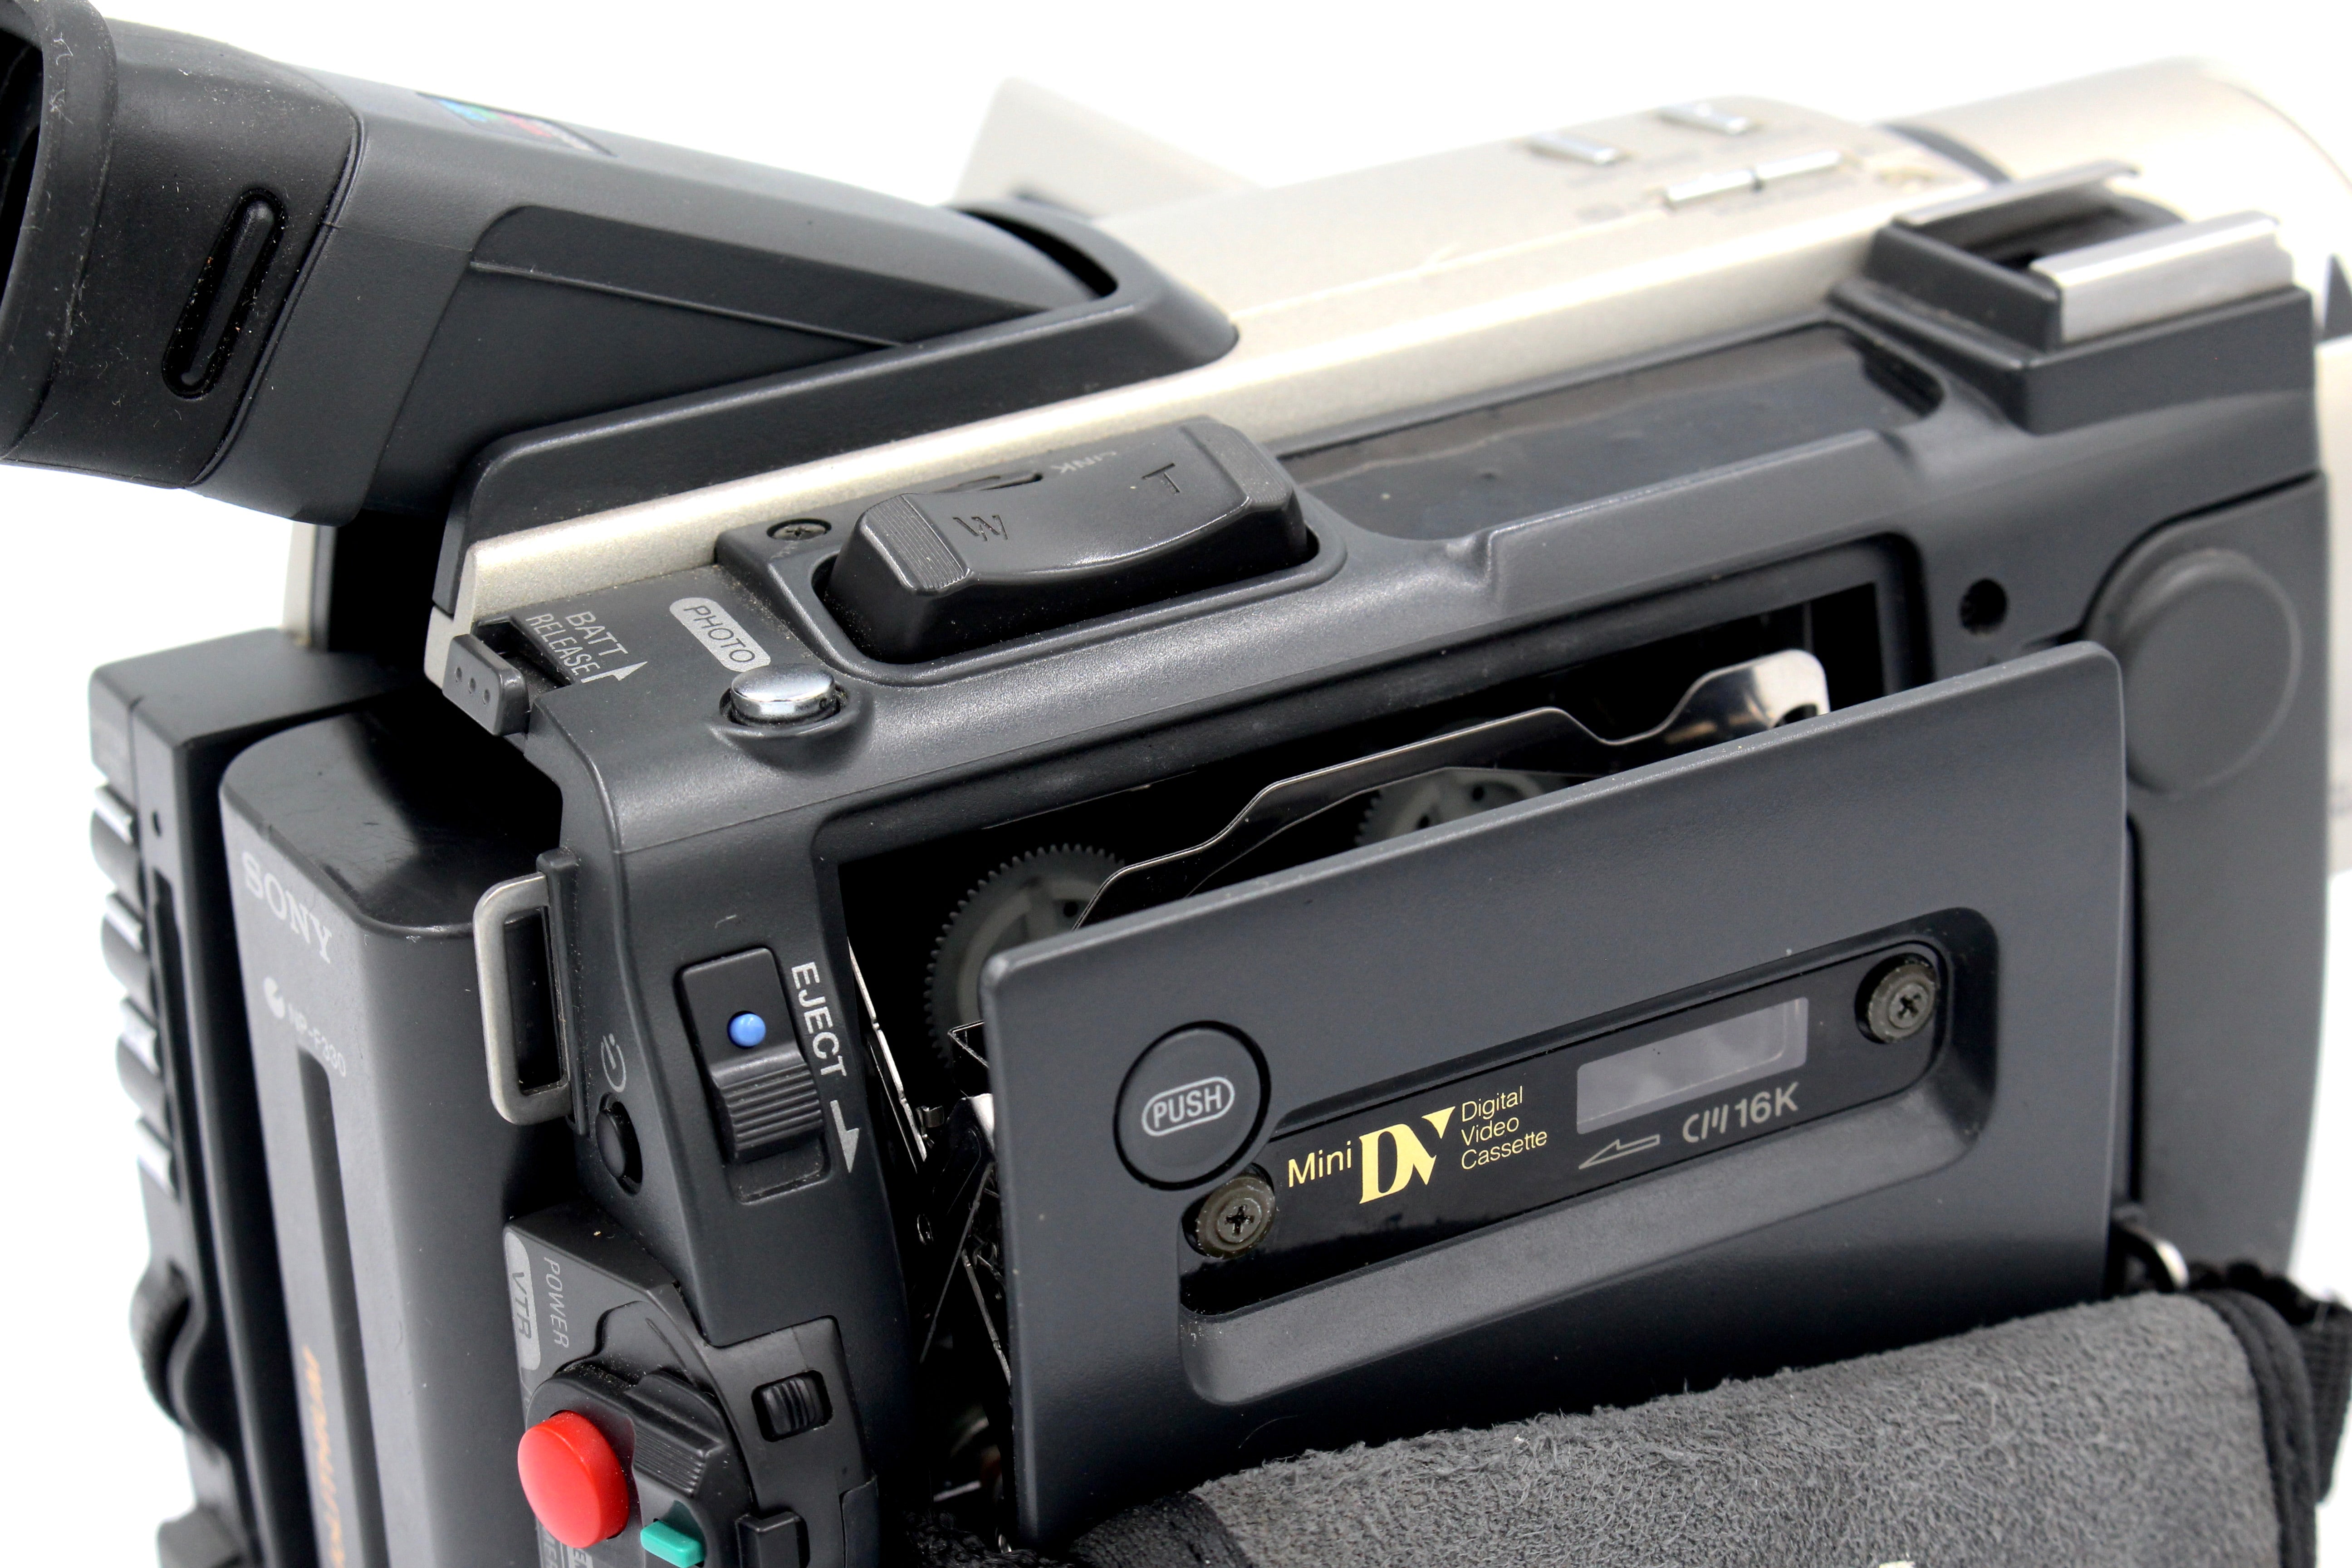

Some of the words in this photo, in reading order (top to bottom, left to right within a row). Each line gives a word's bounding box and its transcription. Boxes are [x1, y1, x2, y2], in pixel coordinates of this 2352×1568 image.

[1141, 462, 1180, 495] T
[952, 514, 1009, 541] W
[525, 613, 600, 676] RELEASE
[565, 611, 628, 656] BATT
[683, 605, 755, 663] PHOTO
[242, 851, 332, 963] SONY
[792, 961, 847, 1077] EJECT
[1153, 1084, 1222, 1127] PUSH
[1462, 1085, 1523, 1122] Digital
[1734, 1081, 1799, 1123] 16K
[1461, 1117, 1519, 1146] Video
[1461, 1131, 1548, 1170] Cassette
[1288, 1140, 1352, 1187] Mini
[1359, 1106, 1456, 1204] DV
[511, 1272, 532, 1340] VTR
[544, 1257, 569, 1348] POWER
